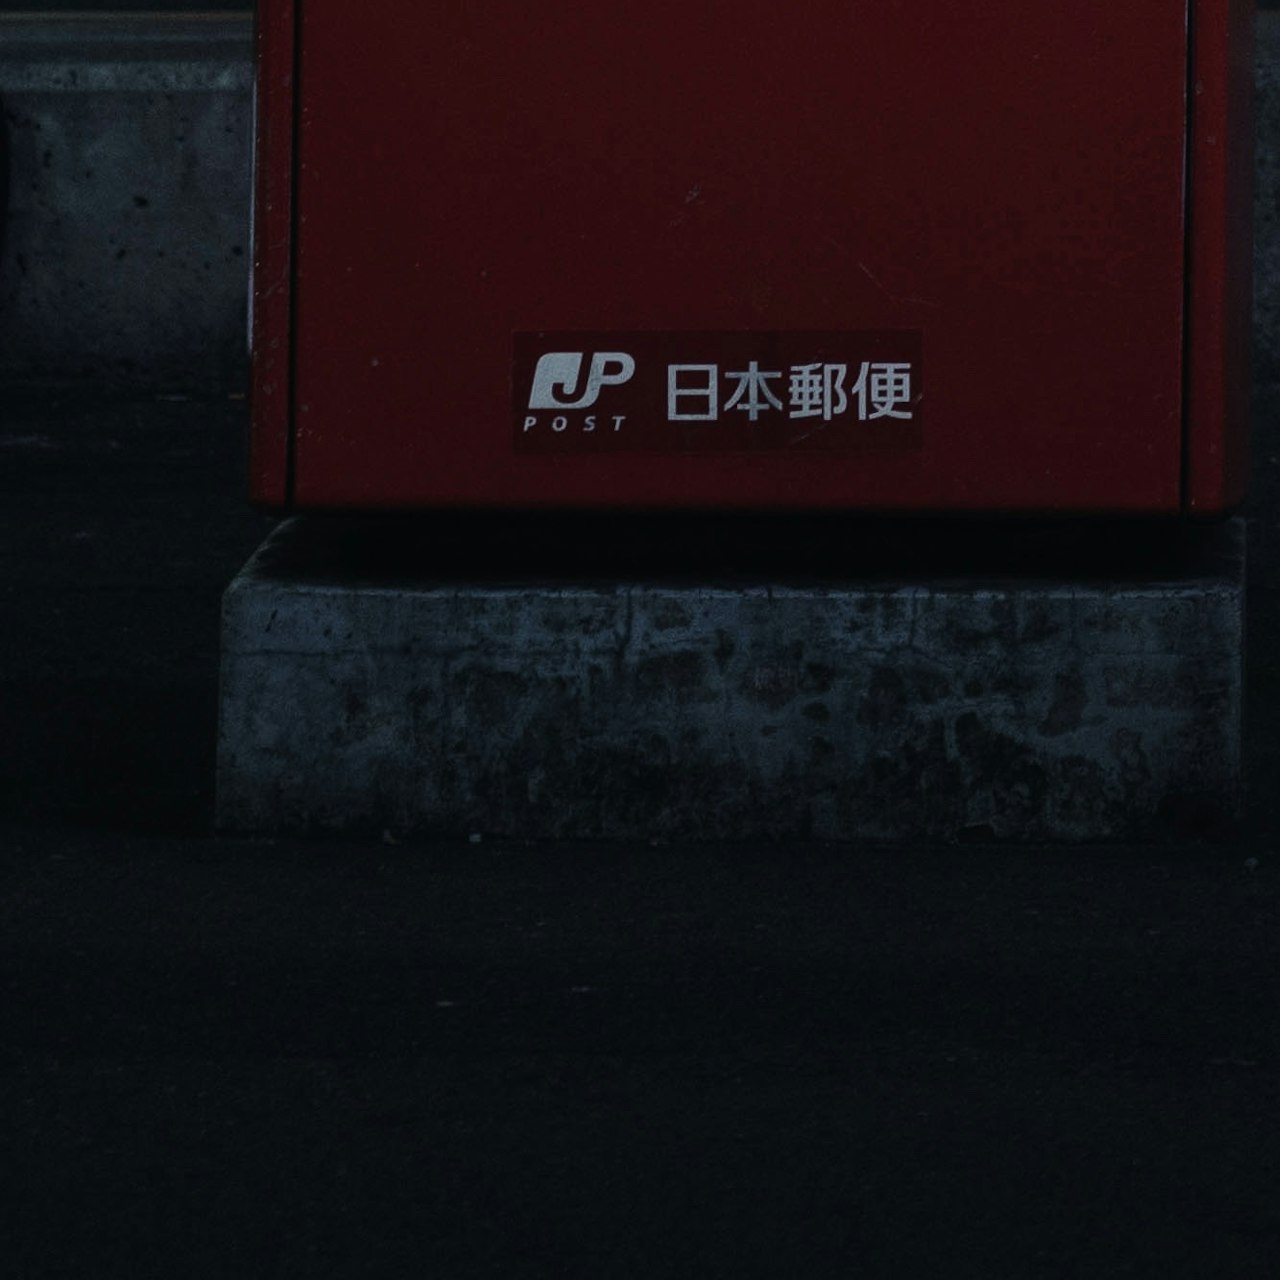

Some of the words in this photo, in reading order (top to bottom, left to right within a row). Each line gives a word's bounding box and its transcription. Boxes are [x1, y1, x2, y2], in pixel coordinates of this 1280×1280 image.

[527, 351, 636, 410] JP
[667, 360, 914, 422] 日本郵便
[522, 415, 628, 433] POST
